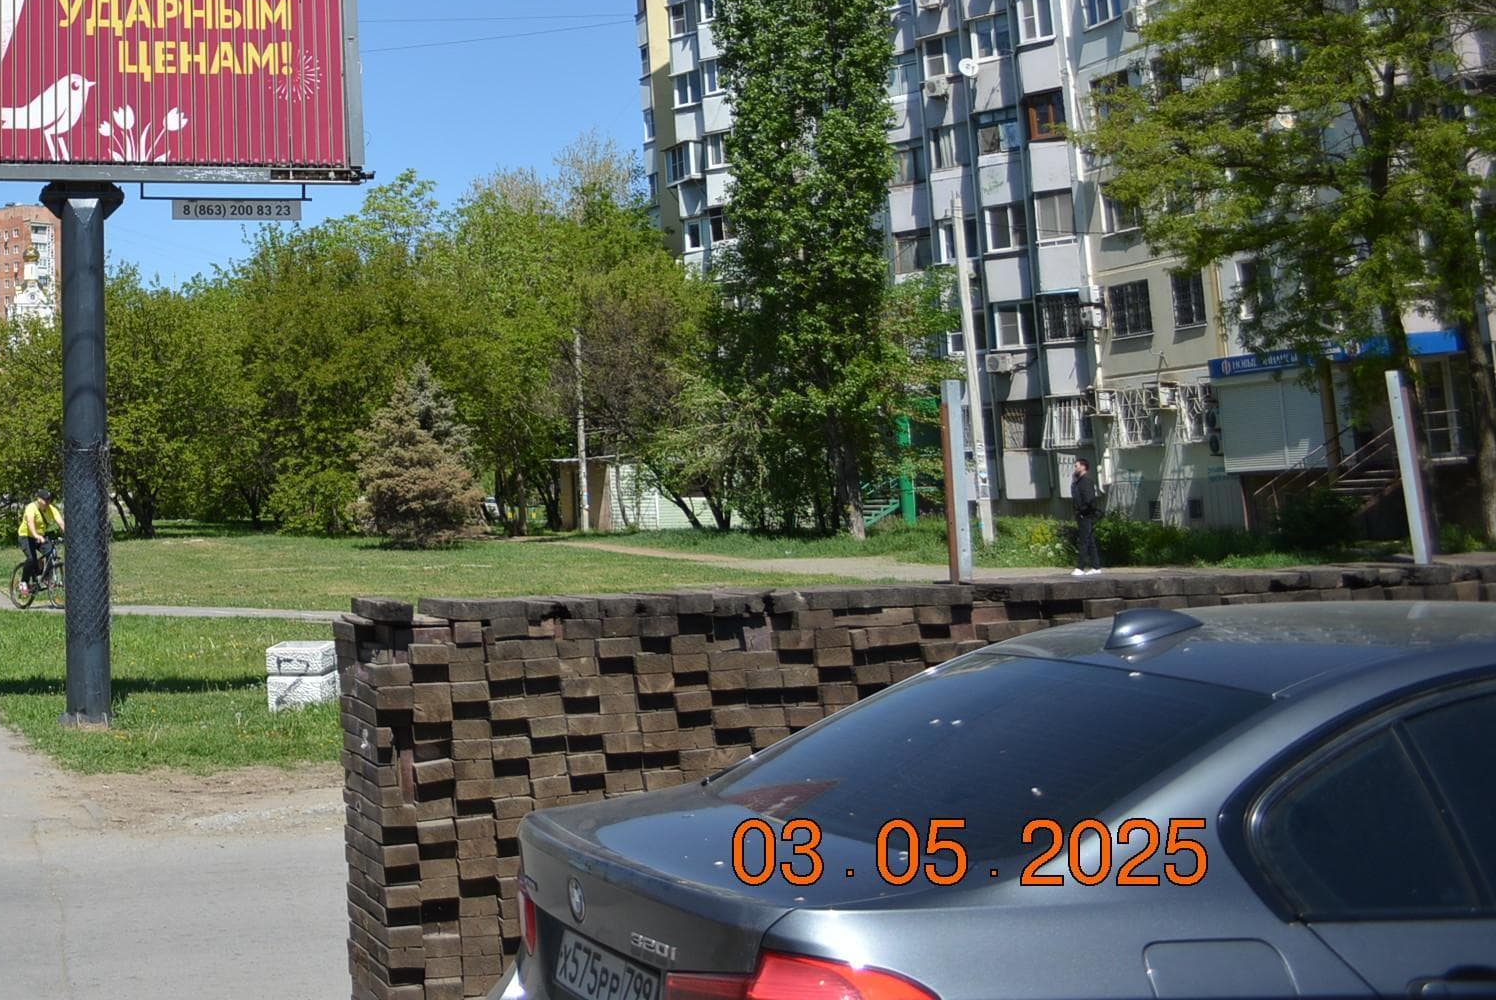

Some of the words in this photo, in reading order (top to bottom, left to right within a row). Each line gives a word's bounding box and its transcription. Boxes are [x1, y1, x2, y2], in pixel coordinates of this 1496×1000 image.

[119, 41, 293, 82] ЦЕНАМ!
[183, 205, 190, 216] 8
[194, 204, 226, 218] (863)
[230, 205, 253, 216] 200
[257, 205, 272, 216] 83
[275, 205, 291, 216] 23
